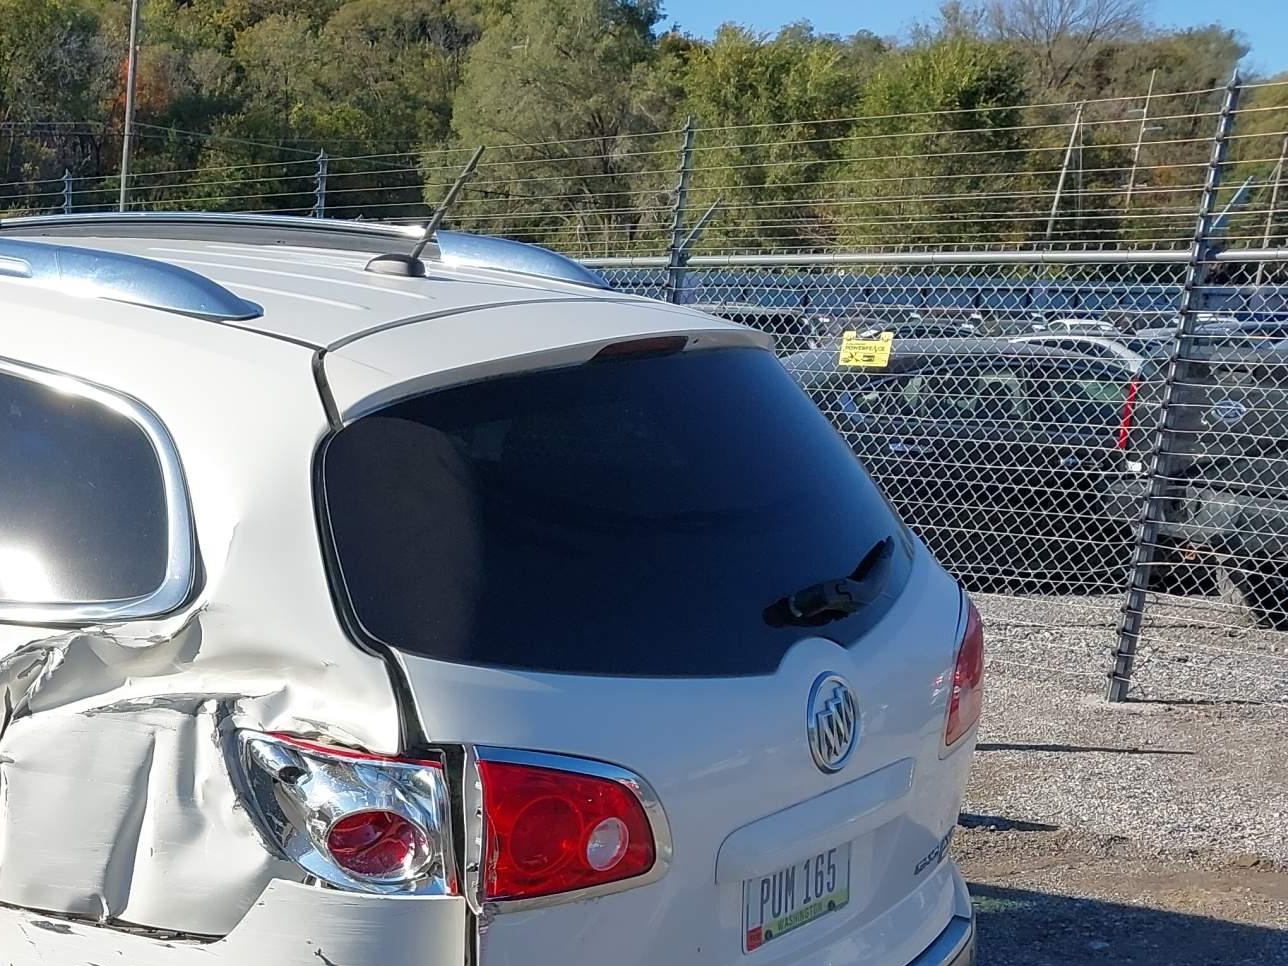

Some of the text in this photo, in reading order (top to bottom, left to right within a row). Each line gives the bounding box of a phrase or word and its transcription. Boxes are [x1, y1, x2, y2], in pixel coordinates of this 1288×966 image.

[760, 847, 837, 924] PUM 165
[777, 901, 823, 931] WASHINGTON
